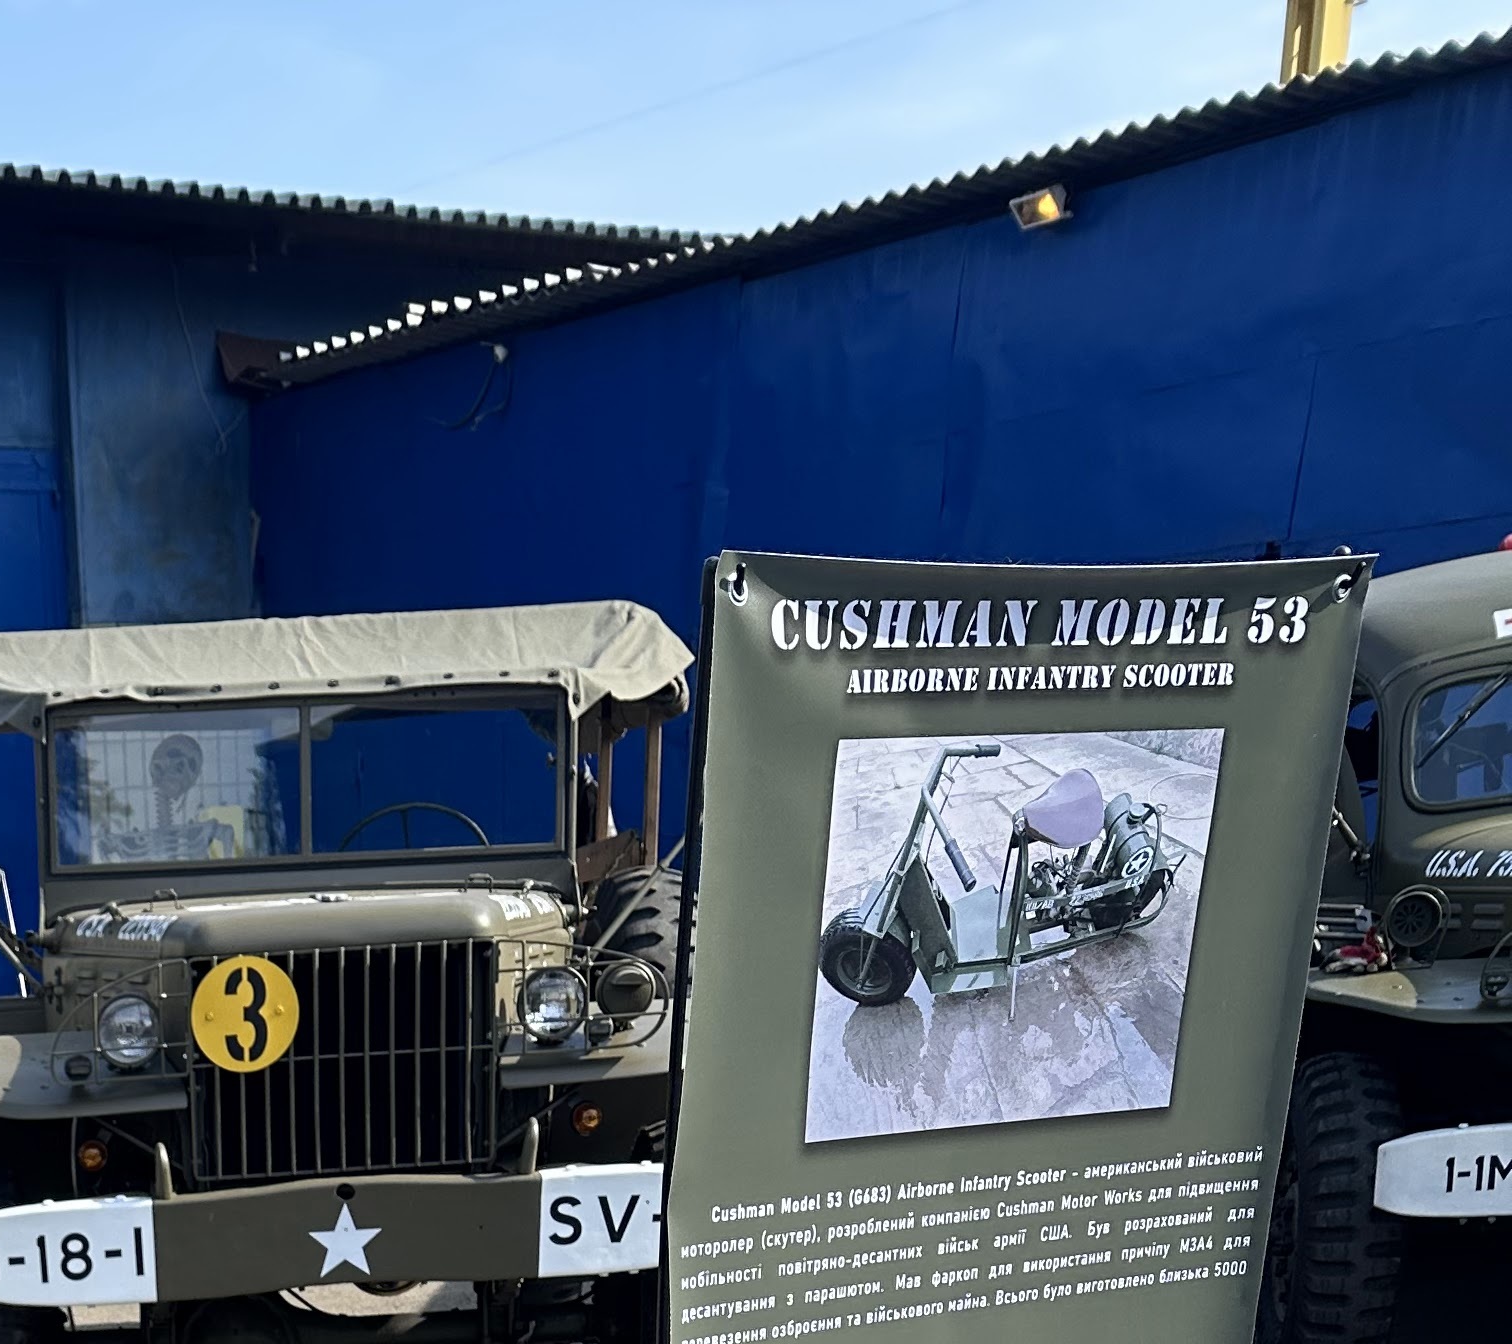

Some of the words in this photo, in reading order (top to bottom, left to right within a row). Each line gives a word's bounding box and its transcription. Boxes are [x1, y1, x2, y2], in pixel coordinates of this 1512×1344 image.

[772, 600, 1035, 650] CUSHMAN
[1052, 598, 1227, 647] MODEL
[1248, 595, 1308, 643] 53
[847, 667, 979, 693] AIRBORNE
[987, 665, 1116, 691] INFANTRY
[1123, 662, 1233, 687] SCOOTER
[224, 966, 268, 1062] 3
[680, 1237, 754, 1259] моторолер
[827, 1212, 915, 1243] розроблений
[921, 1206, 991, 1227] компанією
[997, 1200, 1055, 1217] Cushman
[1060, 1194, 1099, 1211] Motor
[1104, 1187, 1143, 1205] Works
[1147, 1187, 1173, 1203] для
[1177, 1179, 1259, 1199] підвищення
[711, 1203, 775, 1223] Cushman
[780, 1194, 821, 1214] Model
[826, 1191, 843, 1208] 53
[848, 1185, 892, 1209] (G683)
[897, 1181, 955, 1201] Airborne
[960, 1174, 1012, 1192] Infantry
[1016, 1168, 1067, 1186] Scooter
[1083, 1153, 1183, 1180] американський
[1187, 1146, 1263, 1168] військовий
[681, 1263, 762, 1291] мобільності
[778, 1245, 923, 1277] повітряно-десантних
[937, 1236, 980, 1255] військ
[993, 1228, 1028, 1251] армії
[1040, 1224, 1073, 1242] США.
[1087, 1220, 1111, 1239] Був
[1123, 1206, 1213, 1235] розрахований
[1226, 1207, 1255, 1222] для
[681, 1296, 776, 1325] десантування
[786, 1294, 794, 1306] з
[804, 1281, 885, 1305] парашютом.
[895, 1273, 922, 1290] Мав
[931, 1268, 979, 1288] фаркоп
[987, 1263, 1013, 1280] для
[1022, 1251, 1112, 1273] використання
[1121, 1242, 1171, 1264] причіпу
[1222, 1236, 1251, 1251] для
[771, 1316, 842, 1339] озброєння
[846, 1313, 862, 1326] та
[866, 1302, 944, 1325] військового
[947, 1293, 991, 1312] майна.
[995, 1288, 1039, 1306] Всього
[1043, 1283, 1072, 1302] було
[1076, 1273, 1155, 1294] виготовлено
[1158, 1267, 1210, 1283] близька
[1213, 1260, 1248, 1278] 5000
